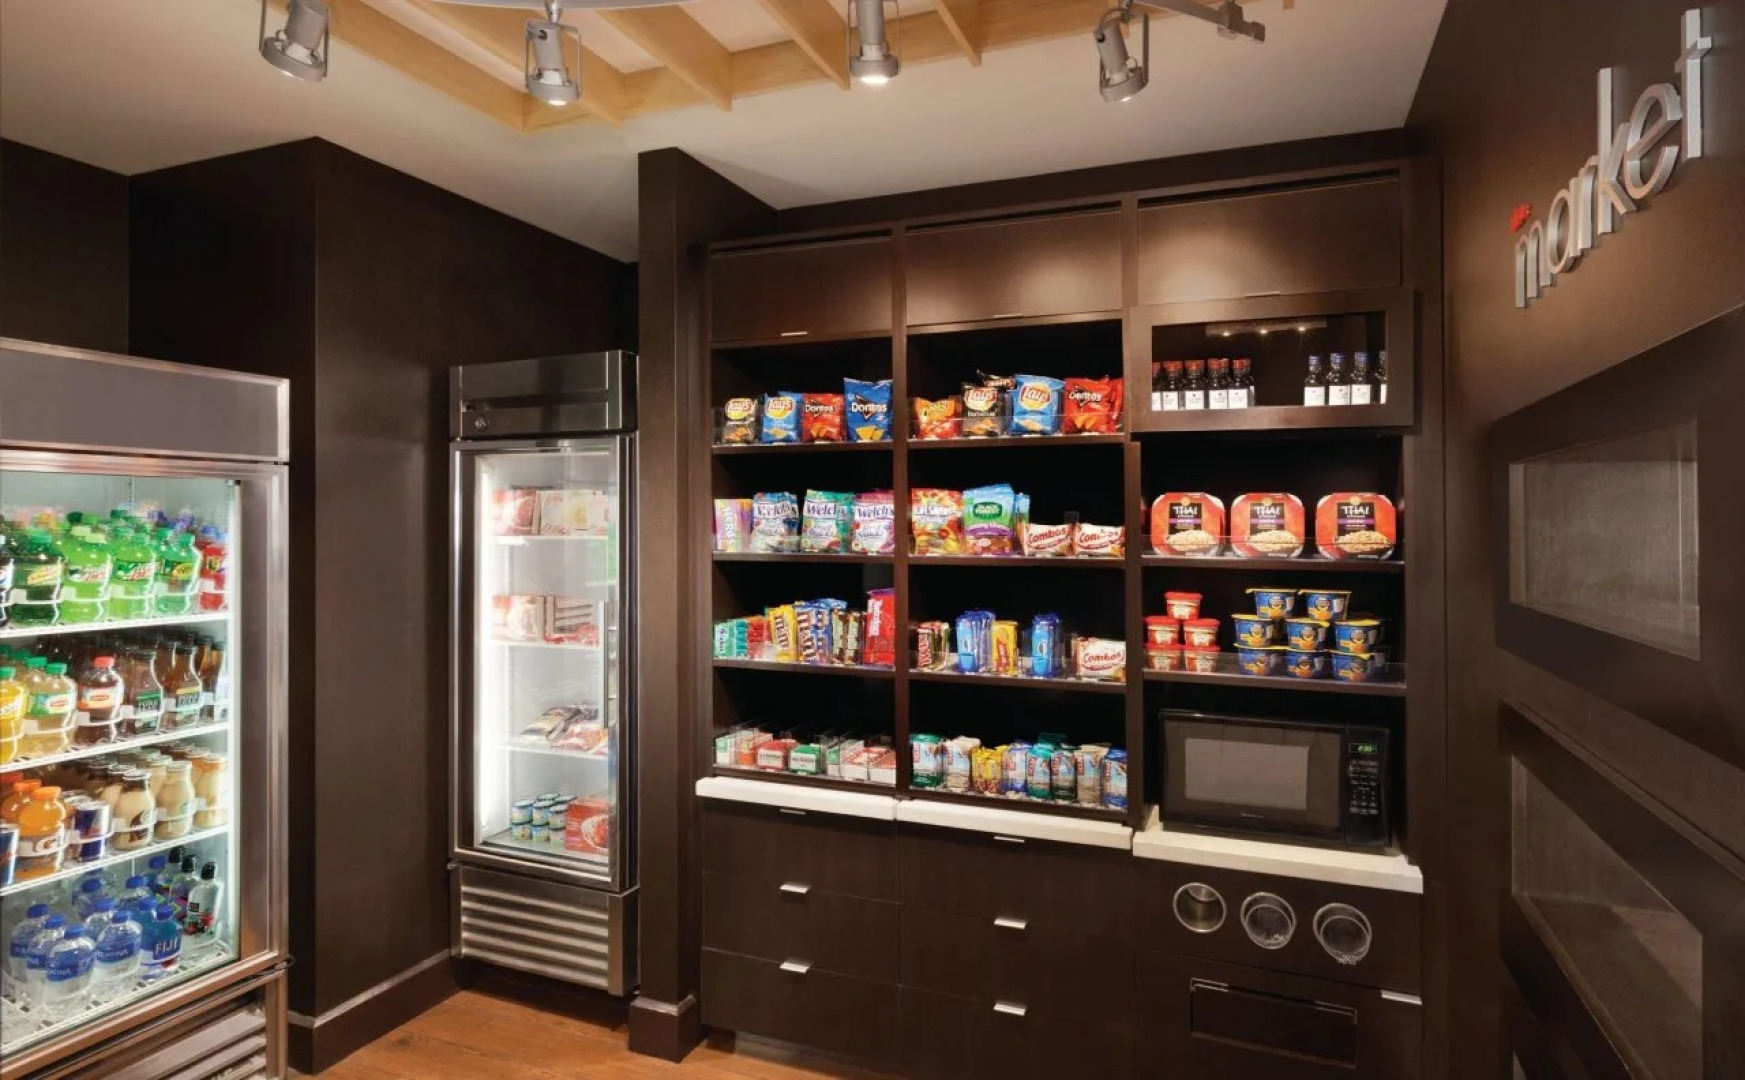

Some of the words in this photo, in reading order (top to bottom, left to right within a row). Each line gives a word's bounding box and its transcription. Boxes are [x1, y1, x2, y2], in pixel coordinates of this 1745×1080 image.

[1515, 8, 1712, 308] market
[1068, 391, 1102, 402] Doritos
[804, 404, 834, 413] Doritos
[850, 401, 887, 413] Doritos
[1172, 505, 1198, 516] THAI
[1253, 505, 1280, 516] THAI
[1341, 505, 1370, 516] THAI
[1028, 527, 1067, 544] Combos
[1084, 650, 1122, 663] Combos
[155, 937, 178, 955] FIJI
